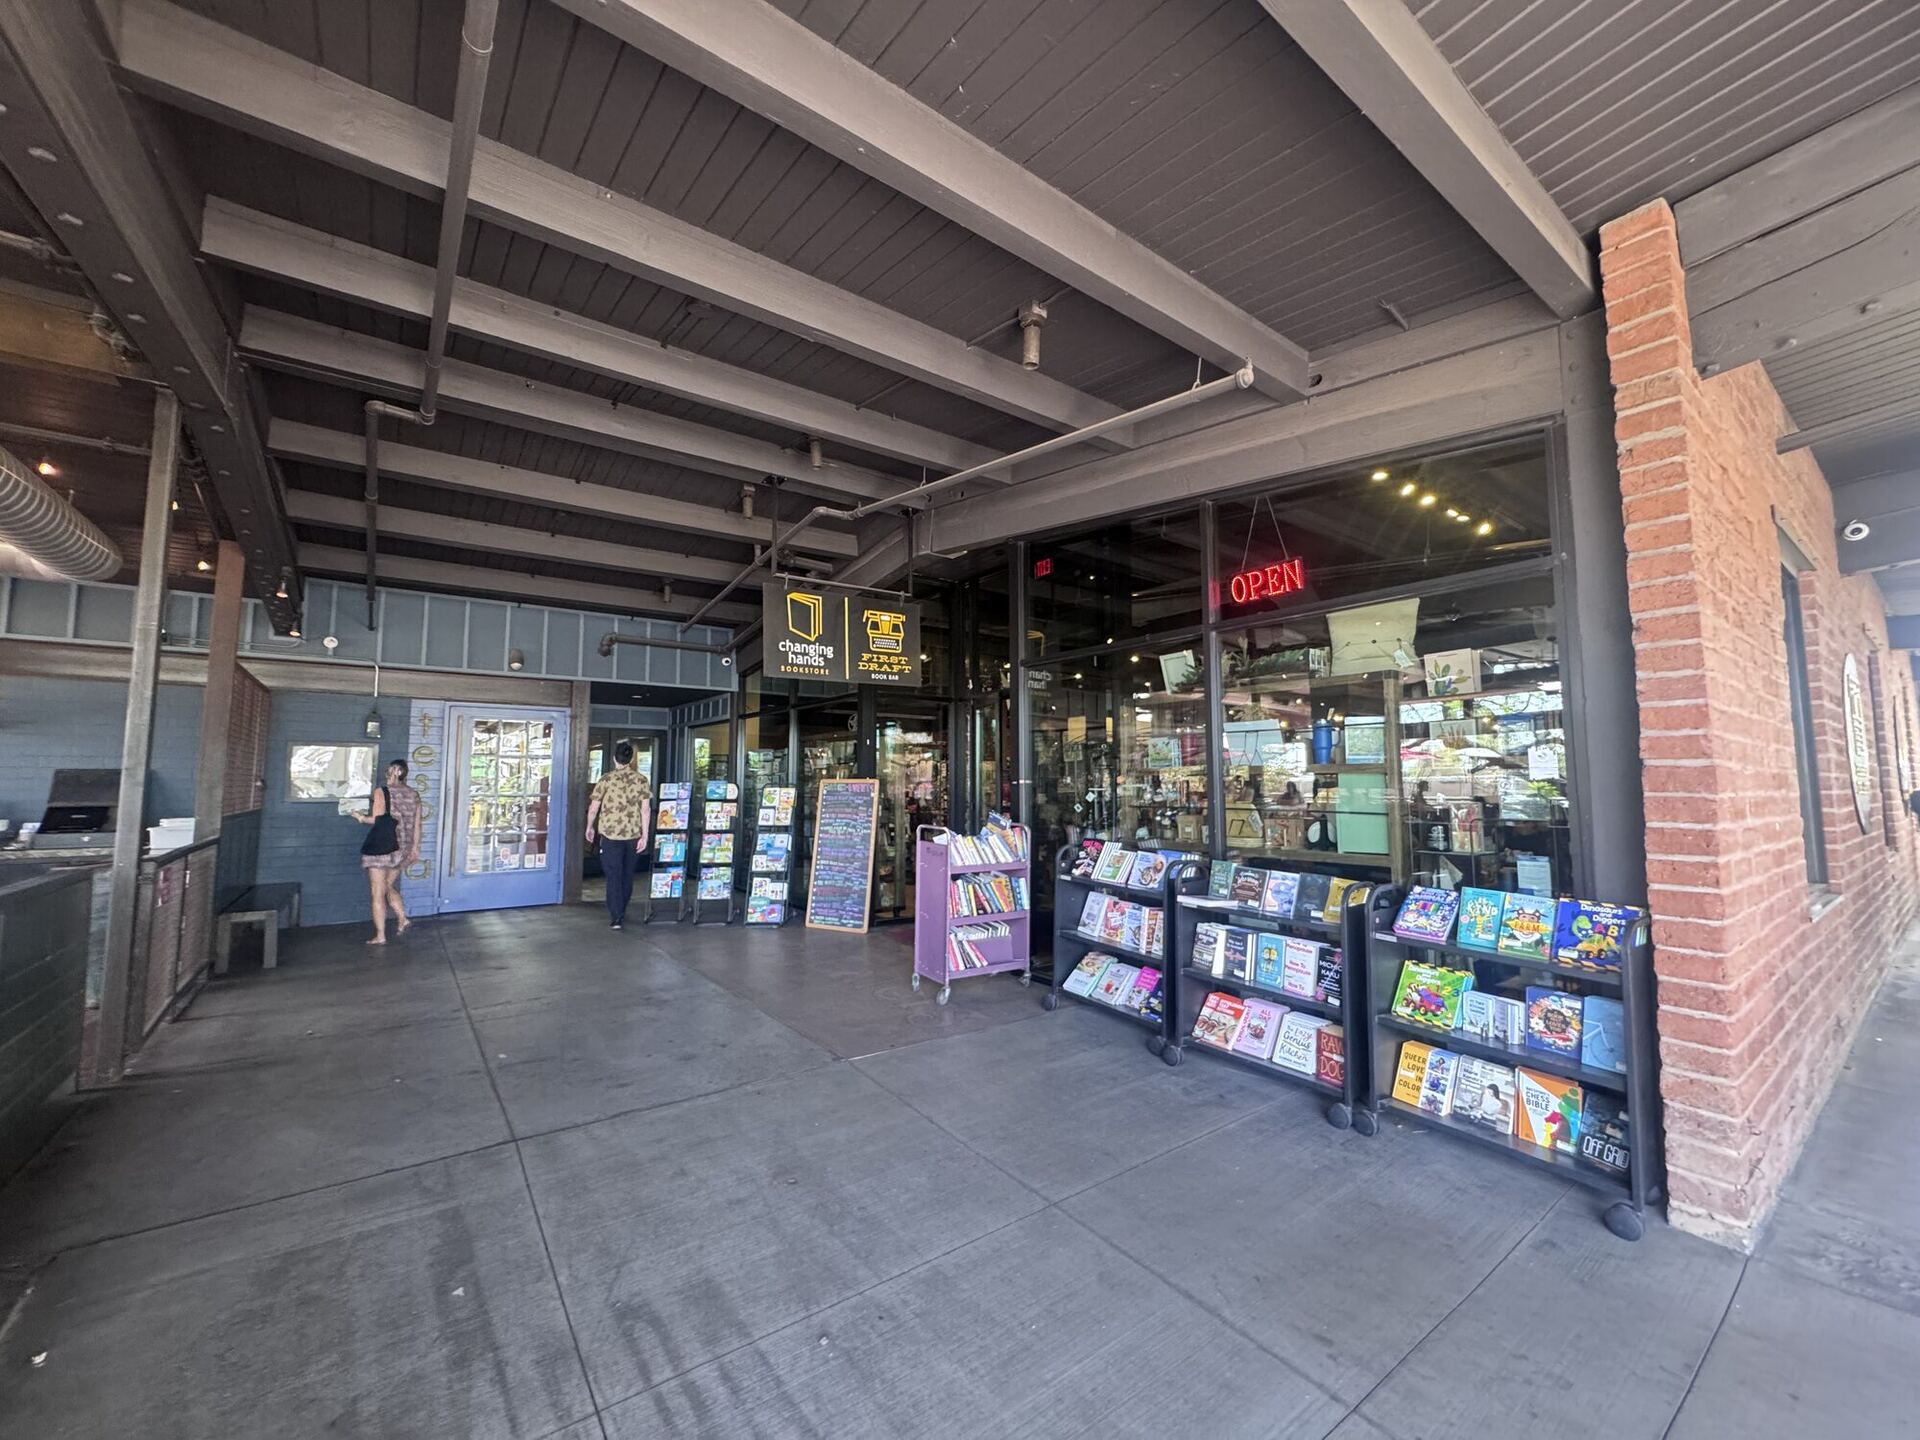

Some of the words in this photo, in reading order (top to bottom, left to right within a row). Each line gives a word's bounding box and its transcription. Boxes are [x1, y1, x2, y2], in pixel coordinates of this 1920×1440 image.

[1231, 558, 1303, 603] OPEN
[778, 639, 834, 658] changing
[788, 651, 825, 667] hands
[861, 653, 909, 665] FIRST
[780, 665, 829, 675] BOOKSTORE
[858, 662, 912, 673] DRAFT
[871, 673, 887, 681] BOOK
[1580, 903, 1623, 915] Dinosaurs
[1592, 915, 1626, 925] Diggers
[1283, 1030, 1311, 1050] Genius
[1294, 1027, 1312, 1041] Lazy
[1279, 1042, 1308, 1062] Kitchen
[1404, 1052, 1427, 1064] QUEER
[1407, 1062, 1425, 1073] LOVE
[1415, 1075, 1423, 1083] IN
[1398, 1079, 1421, 1092] COLOR
[1526, 1091, 1551, 1103] CHESS
[1526, 1098, 1550, 1112] BIBLE
[1582, 1136, 1605, 1157] OFF
[1603, 1144, 1629, 1169] GRID
